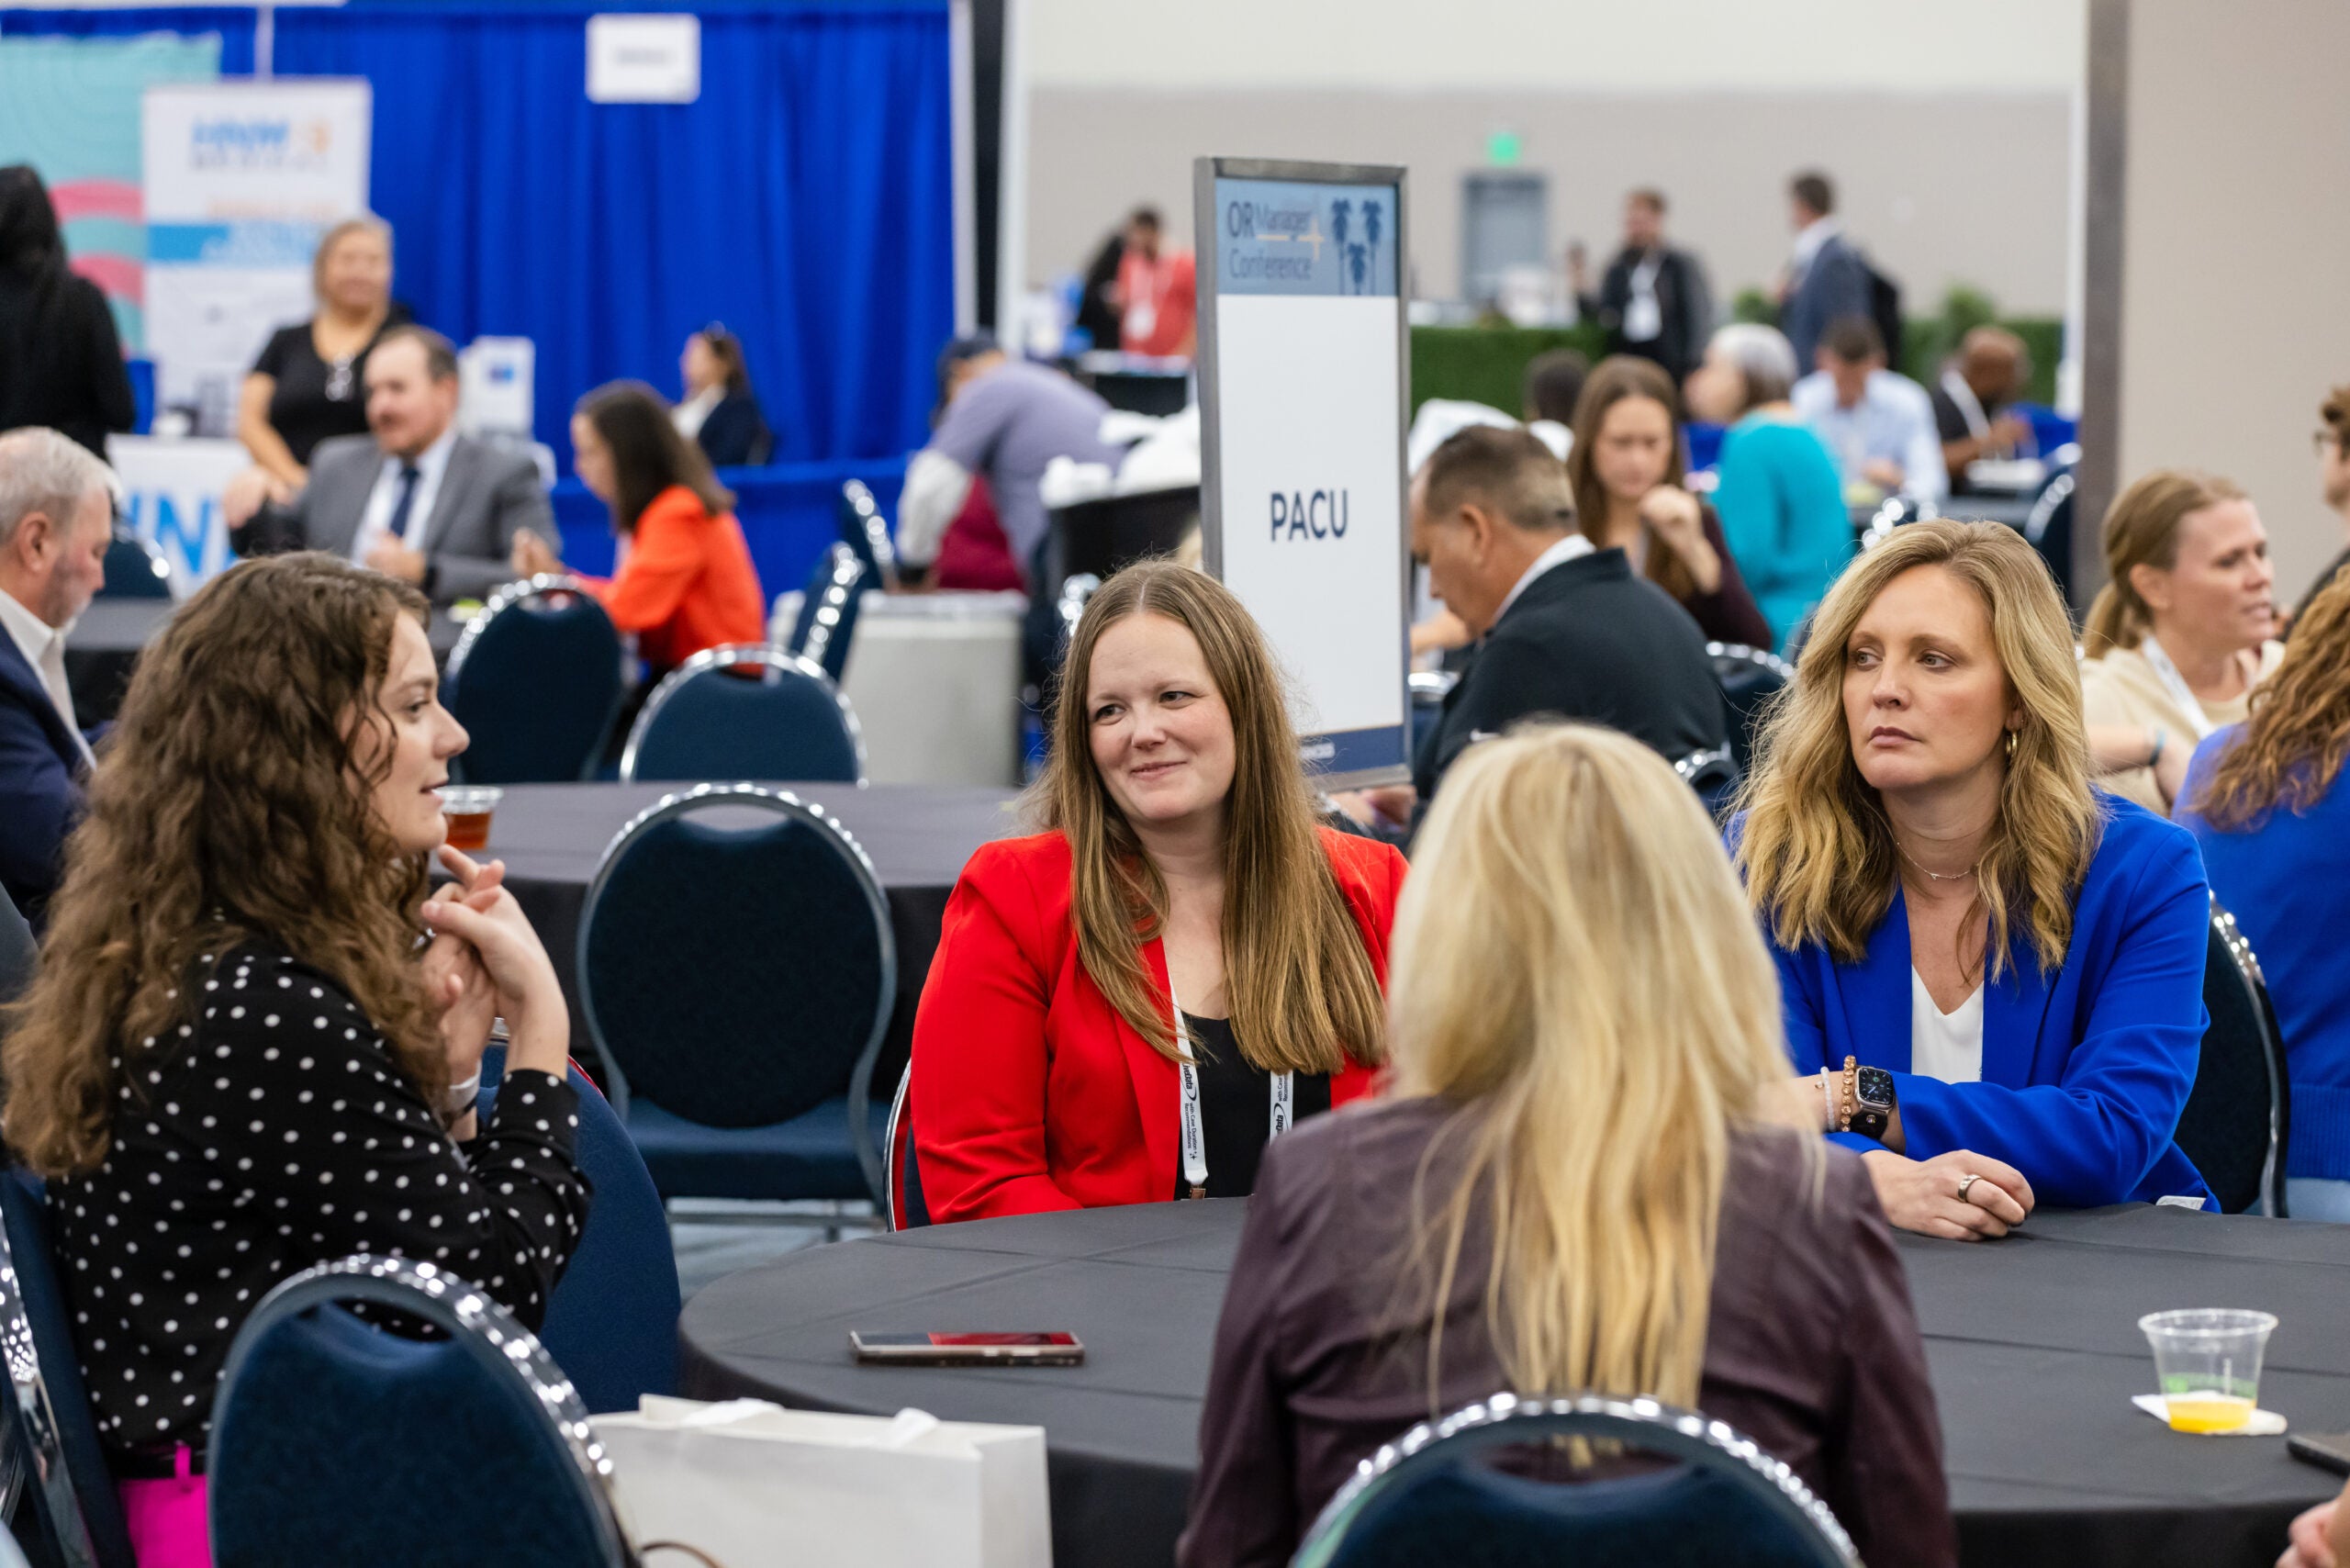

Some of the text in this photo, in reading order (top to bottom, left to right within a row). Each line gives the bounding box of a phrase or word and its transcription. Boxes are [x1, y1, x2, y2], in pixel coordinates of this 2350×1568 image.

[1227, 200, 1255, 239] OR
[1229, 247, 1313, 280] Conference
[1270, 488, 1348, 542] PACU
